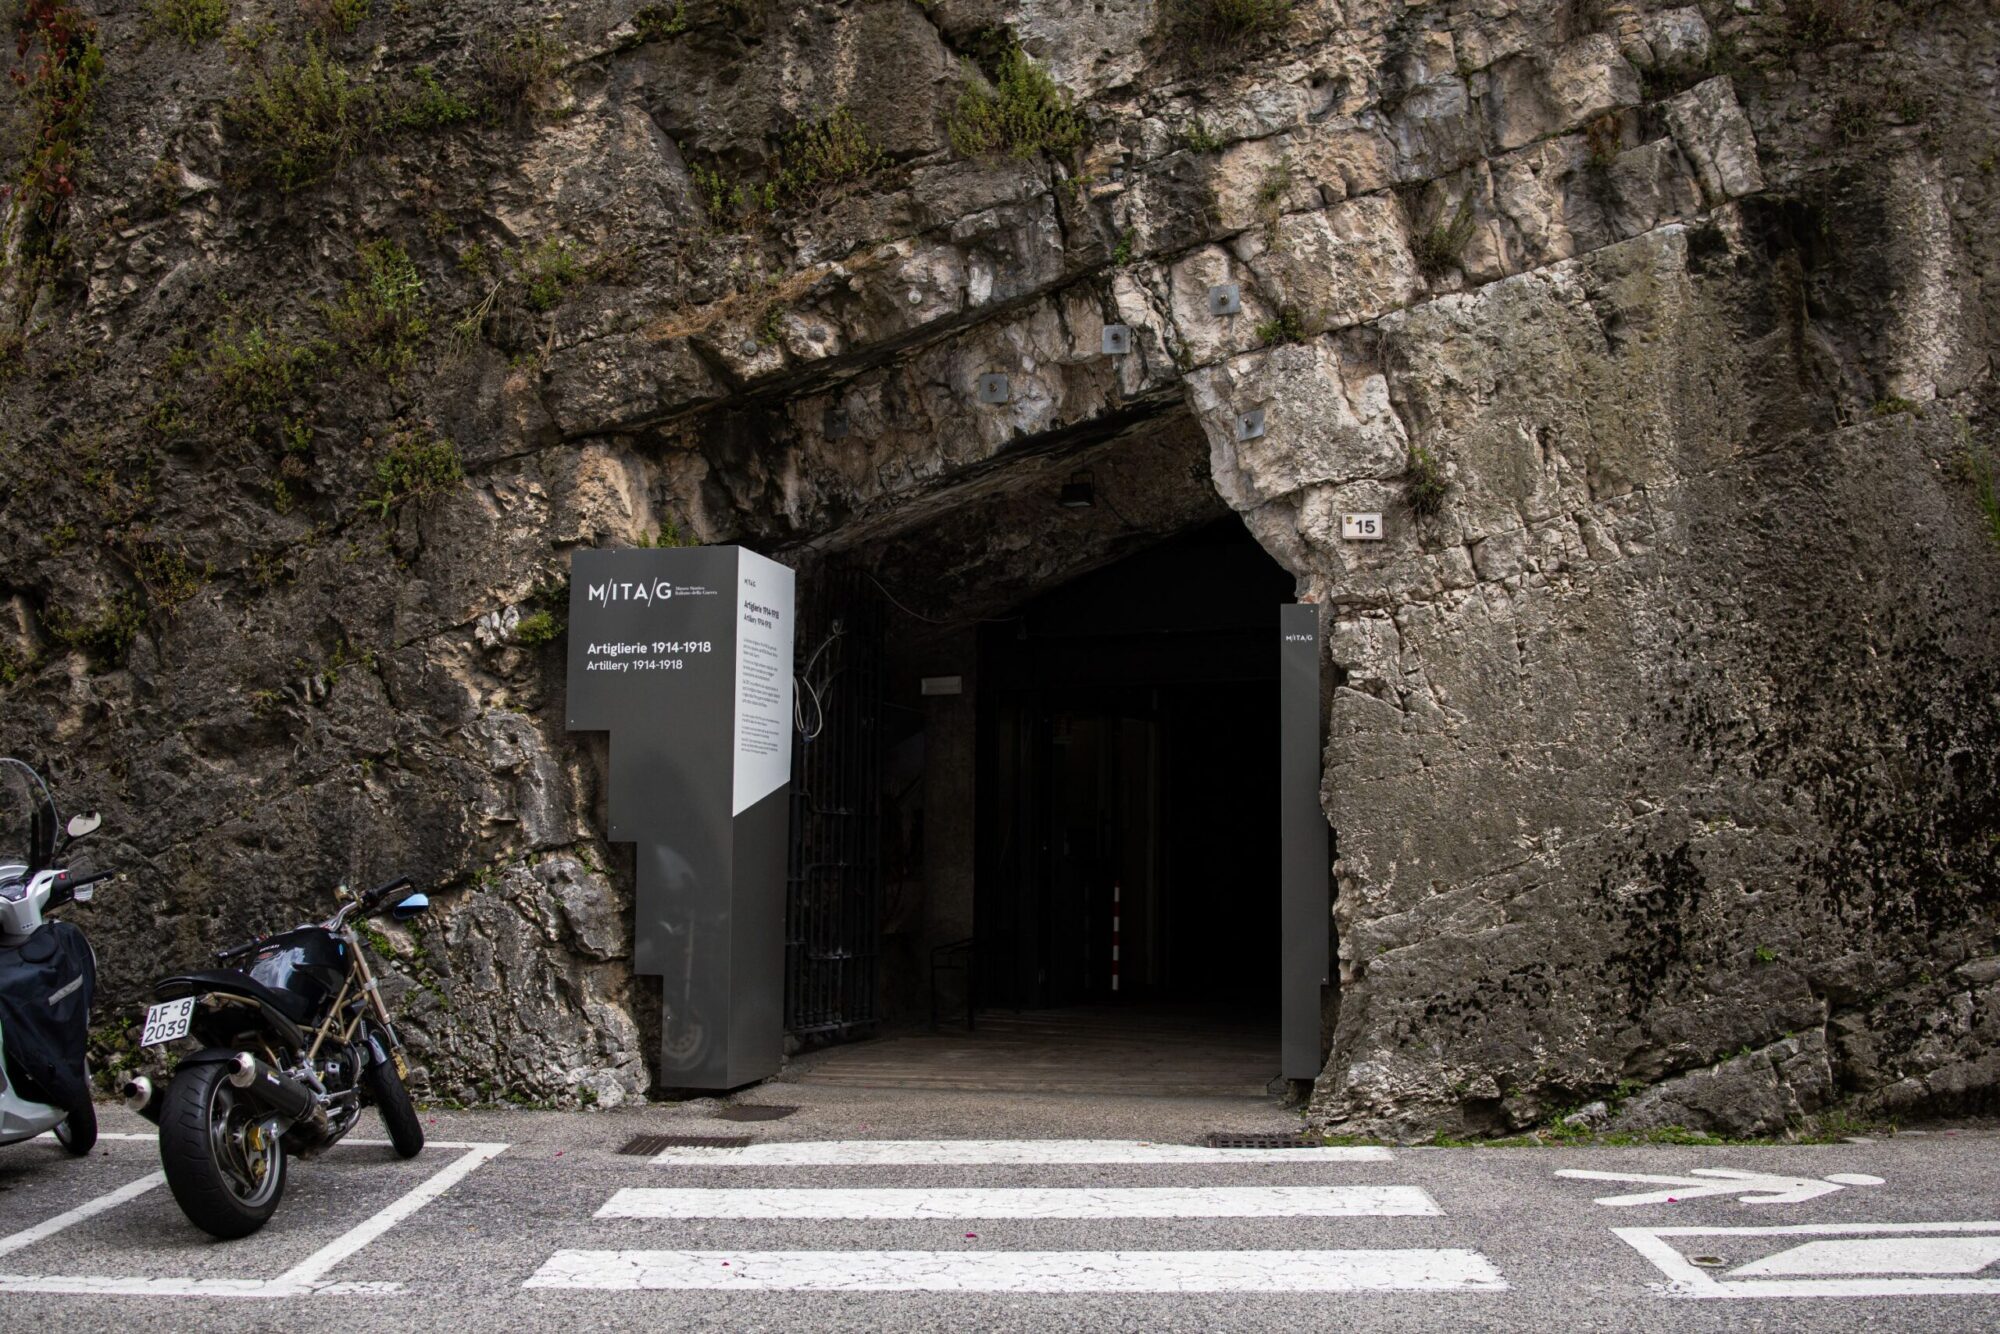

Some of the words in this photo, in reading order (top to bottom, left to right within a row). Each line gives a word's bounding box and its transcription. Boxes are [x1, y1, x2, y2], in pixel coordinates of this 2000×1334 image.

[1355, 520, 1376, 534] 15
[588, 577, 672, 608] M/ITA/G
[587, 642, 648, 657] Artiglierie
[651, 641, 712, 654] 1914-1918
[586, 660, 629, 673] Artillery
[632, 659, 683, 670] 1914-1918
[148, 1005, 171, 1025] AF
[180, 1001, 192, 1017] 8
[144, 1018, 188, 1043] 2039
